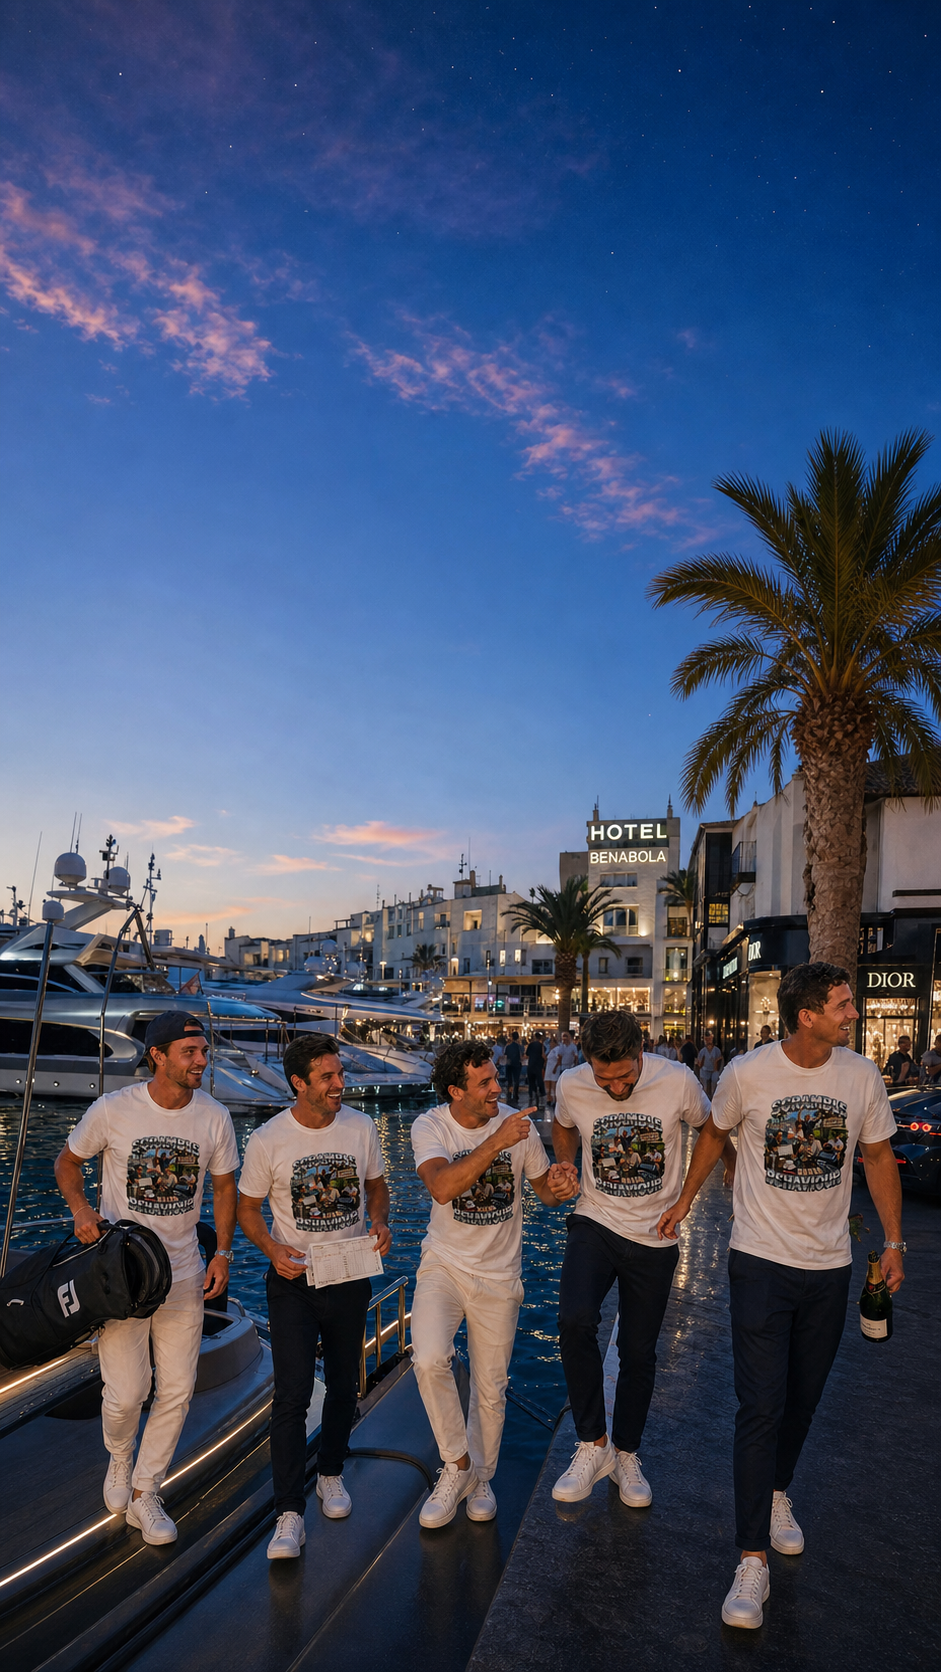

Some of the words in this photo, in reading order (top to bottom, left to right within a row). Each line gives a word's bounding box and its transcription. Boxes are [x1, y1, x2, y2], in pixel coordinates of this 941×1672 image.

[590, 823, 667, 841] HOTEL
[589, 850, 667, 864] BENABOLA
[866, 972, 916, 988] DIOR
[57, 1279, 80, 1318] FJ
